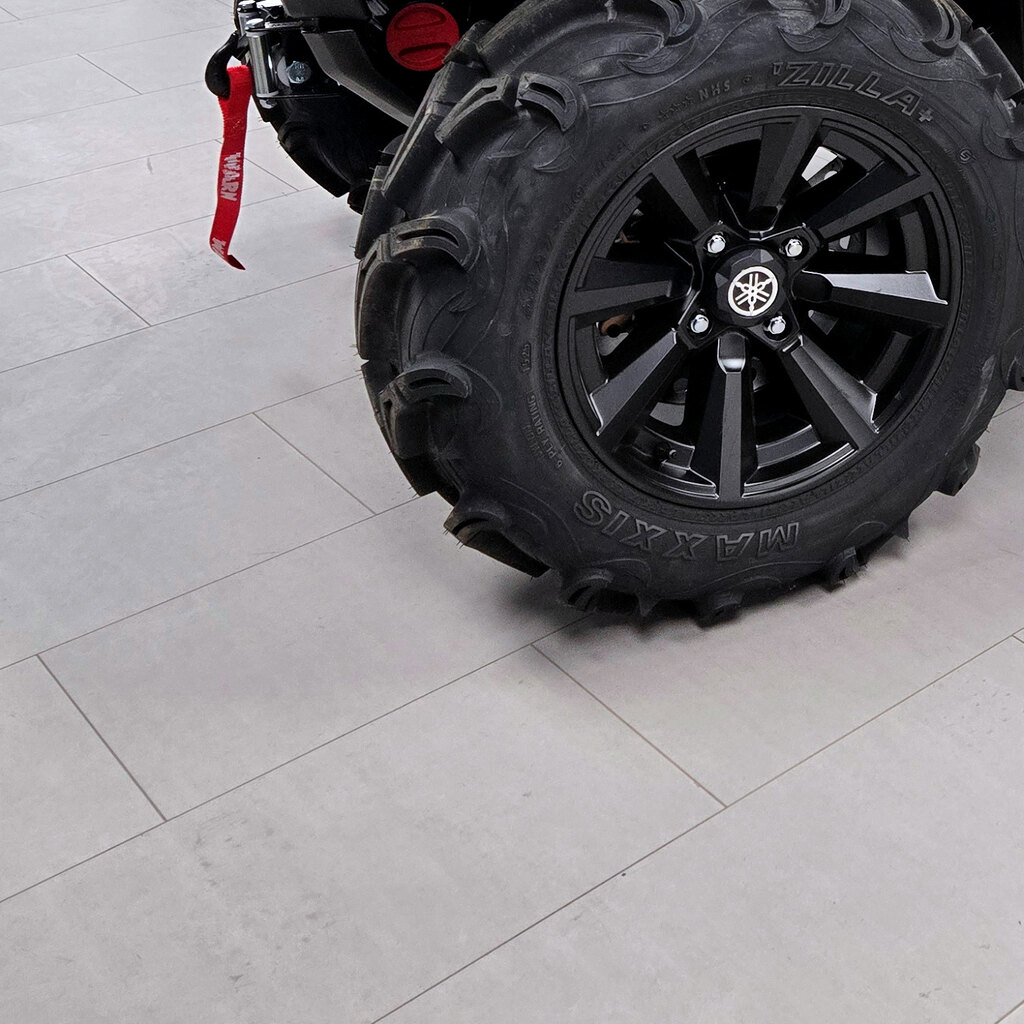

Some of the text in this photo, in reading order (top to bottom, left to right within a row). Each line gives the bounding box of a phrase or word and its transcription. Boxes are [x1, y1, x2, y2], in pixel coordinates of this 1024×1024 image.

[698, 79, 731, 102] NHS
[220, 152, 242, 201] WARN
[573, 490, 800, 562] MAXXIS
